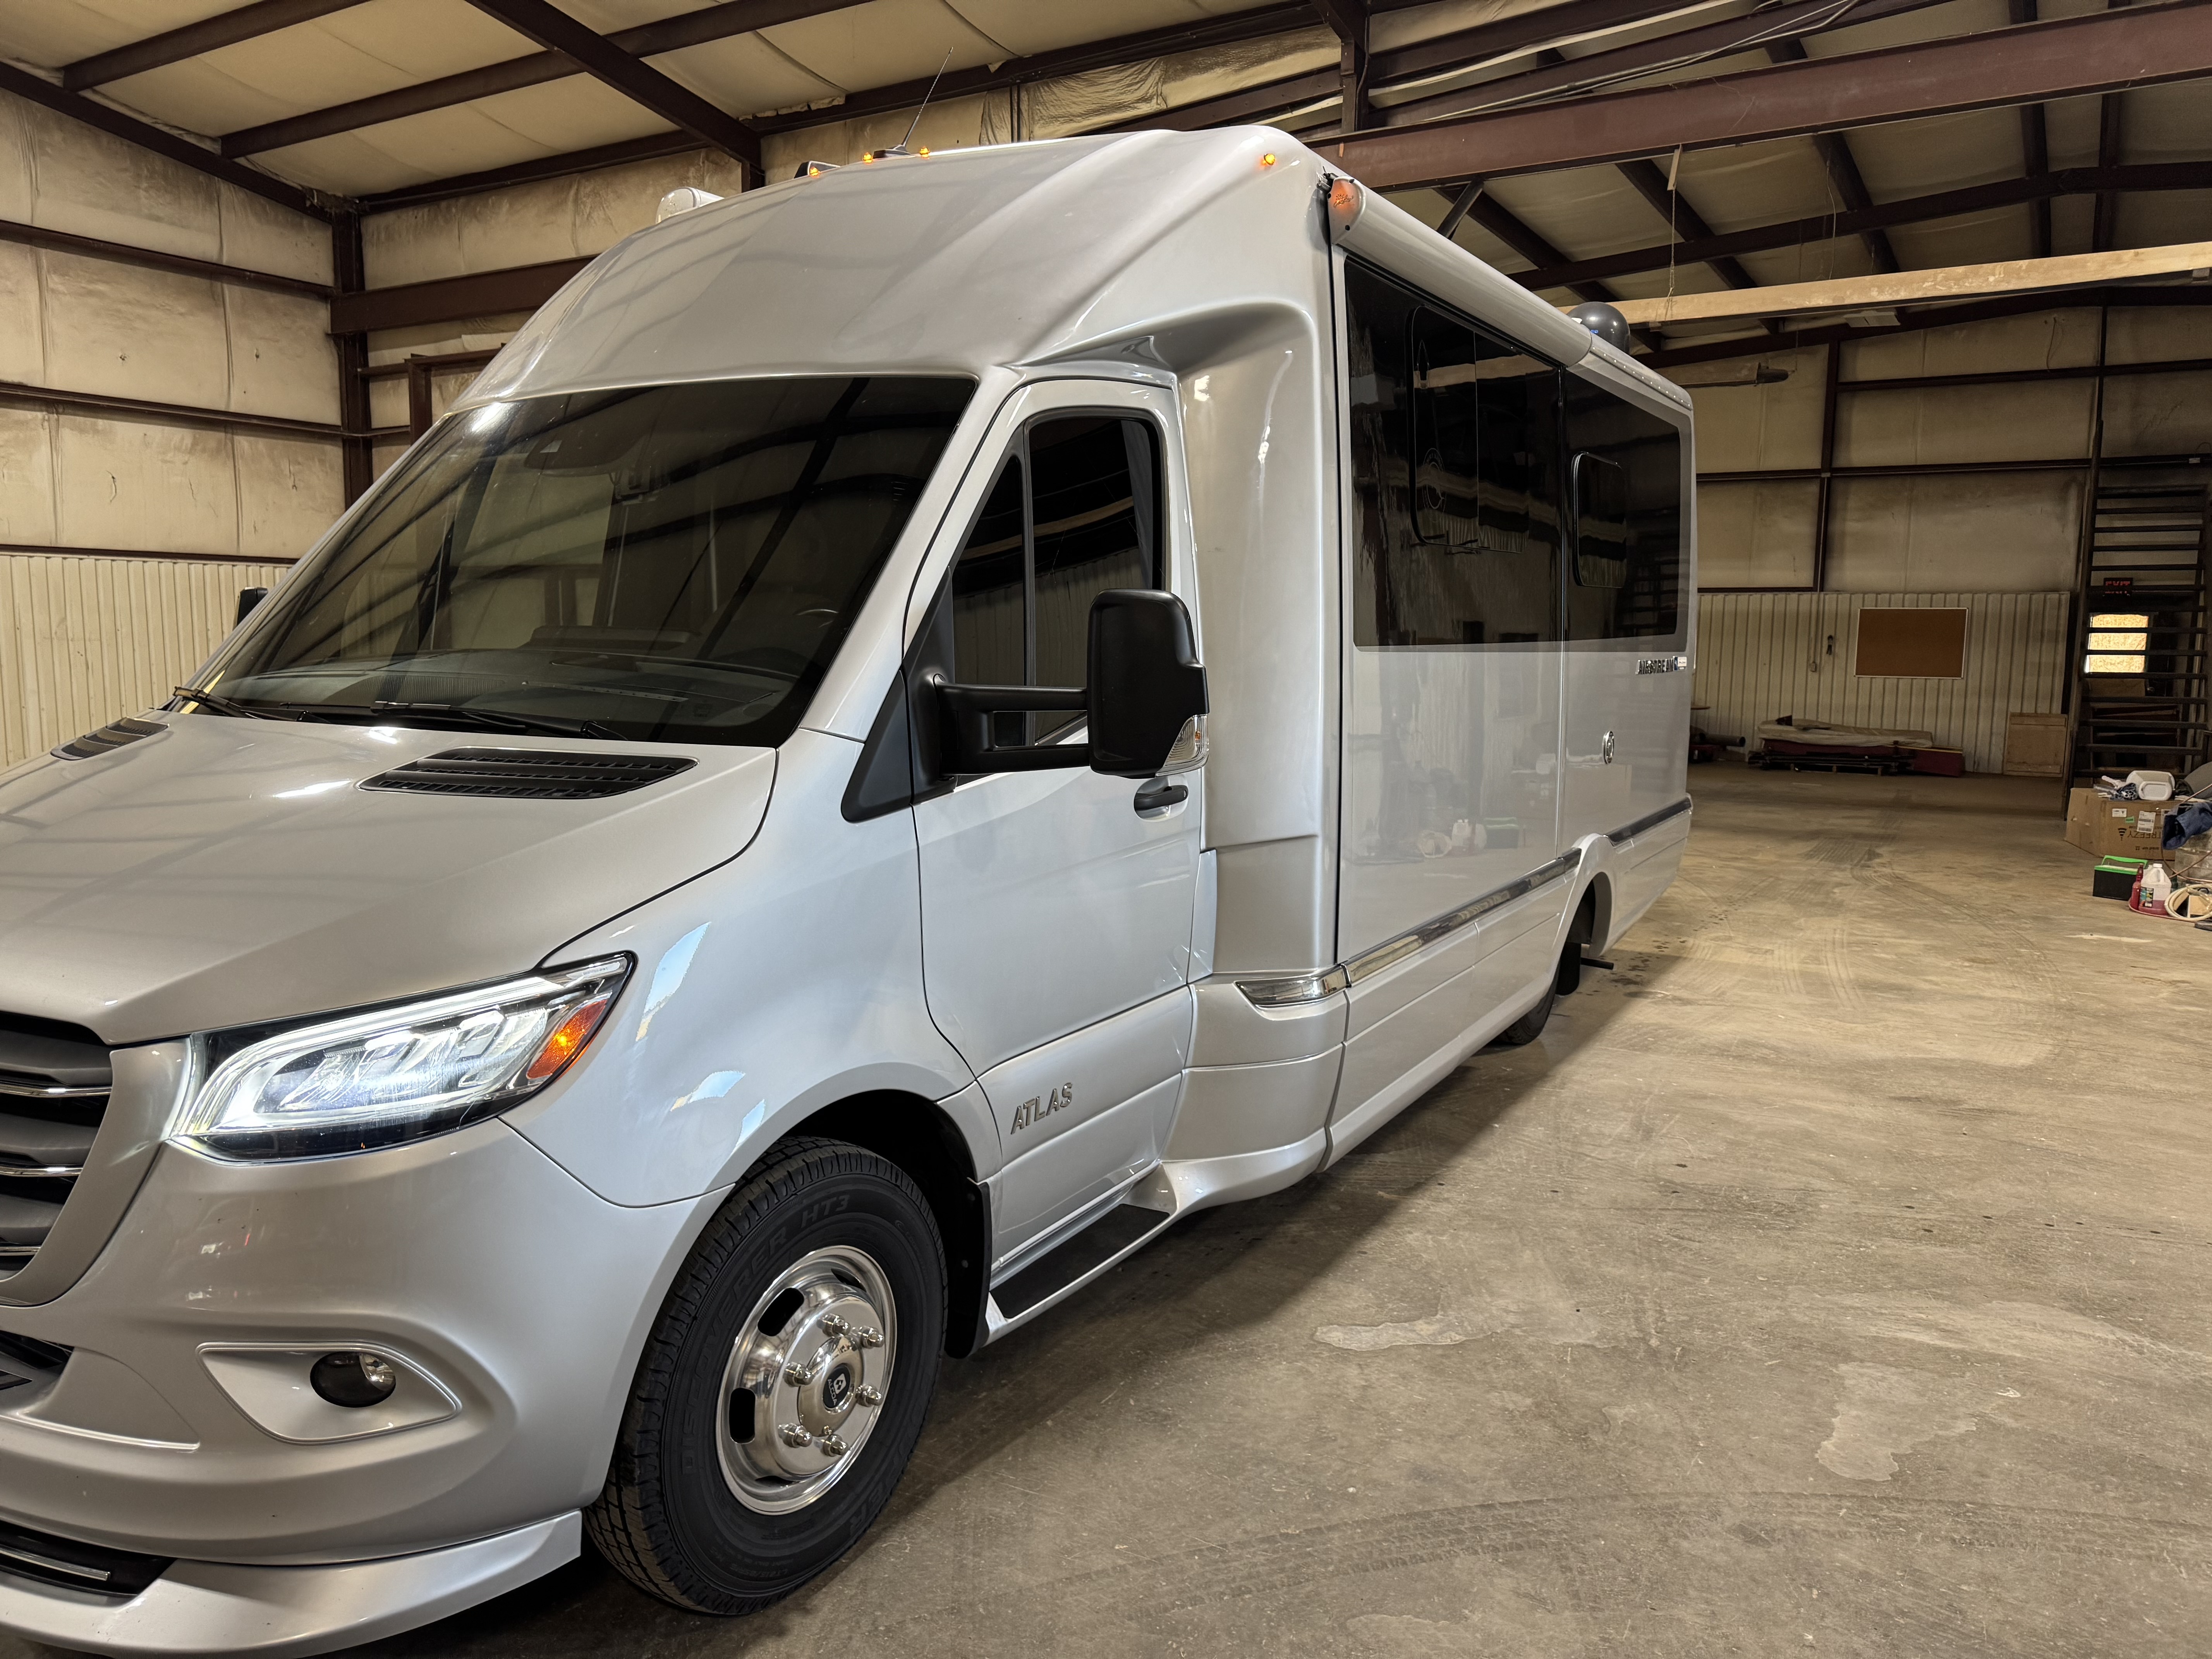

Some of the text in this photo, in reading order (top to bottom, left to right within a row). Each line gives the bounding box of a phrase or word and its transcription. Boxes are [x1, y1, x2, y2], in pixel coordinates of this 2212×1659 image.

[1010, 1082, 1073, 1135] ATLAS
[800, 1194, 850, 1228] HT3
[828, 1379, 837, 1406] ALCOA
